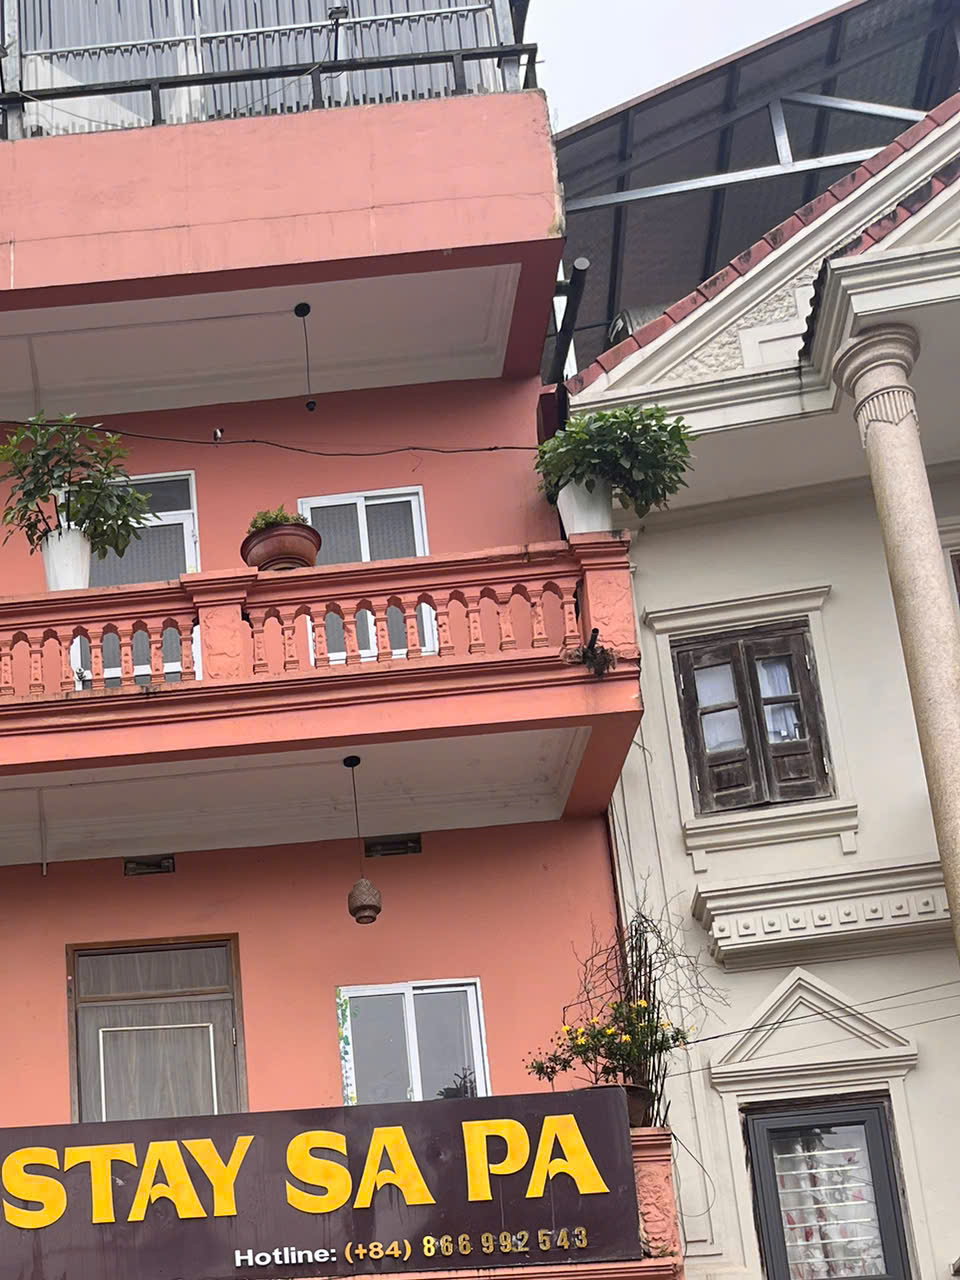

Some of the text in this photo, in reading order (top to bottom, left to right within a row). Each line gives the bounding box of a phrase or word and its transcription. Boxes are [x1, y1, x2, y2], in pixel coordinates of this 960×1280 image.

[285, 1126, 436, 1215] SA
[461, 1114, 610, 1201] PA
[234, 1226, 589, 1268] Hotline: (+84) 866 992 543
